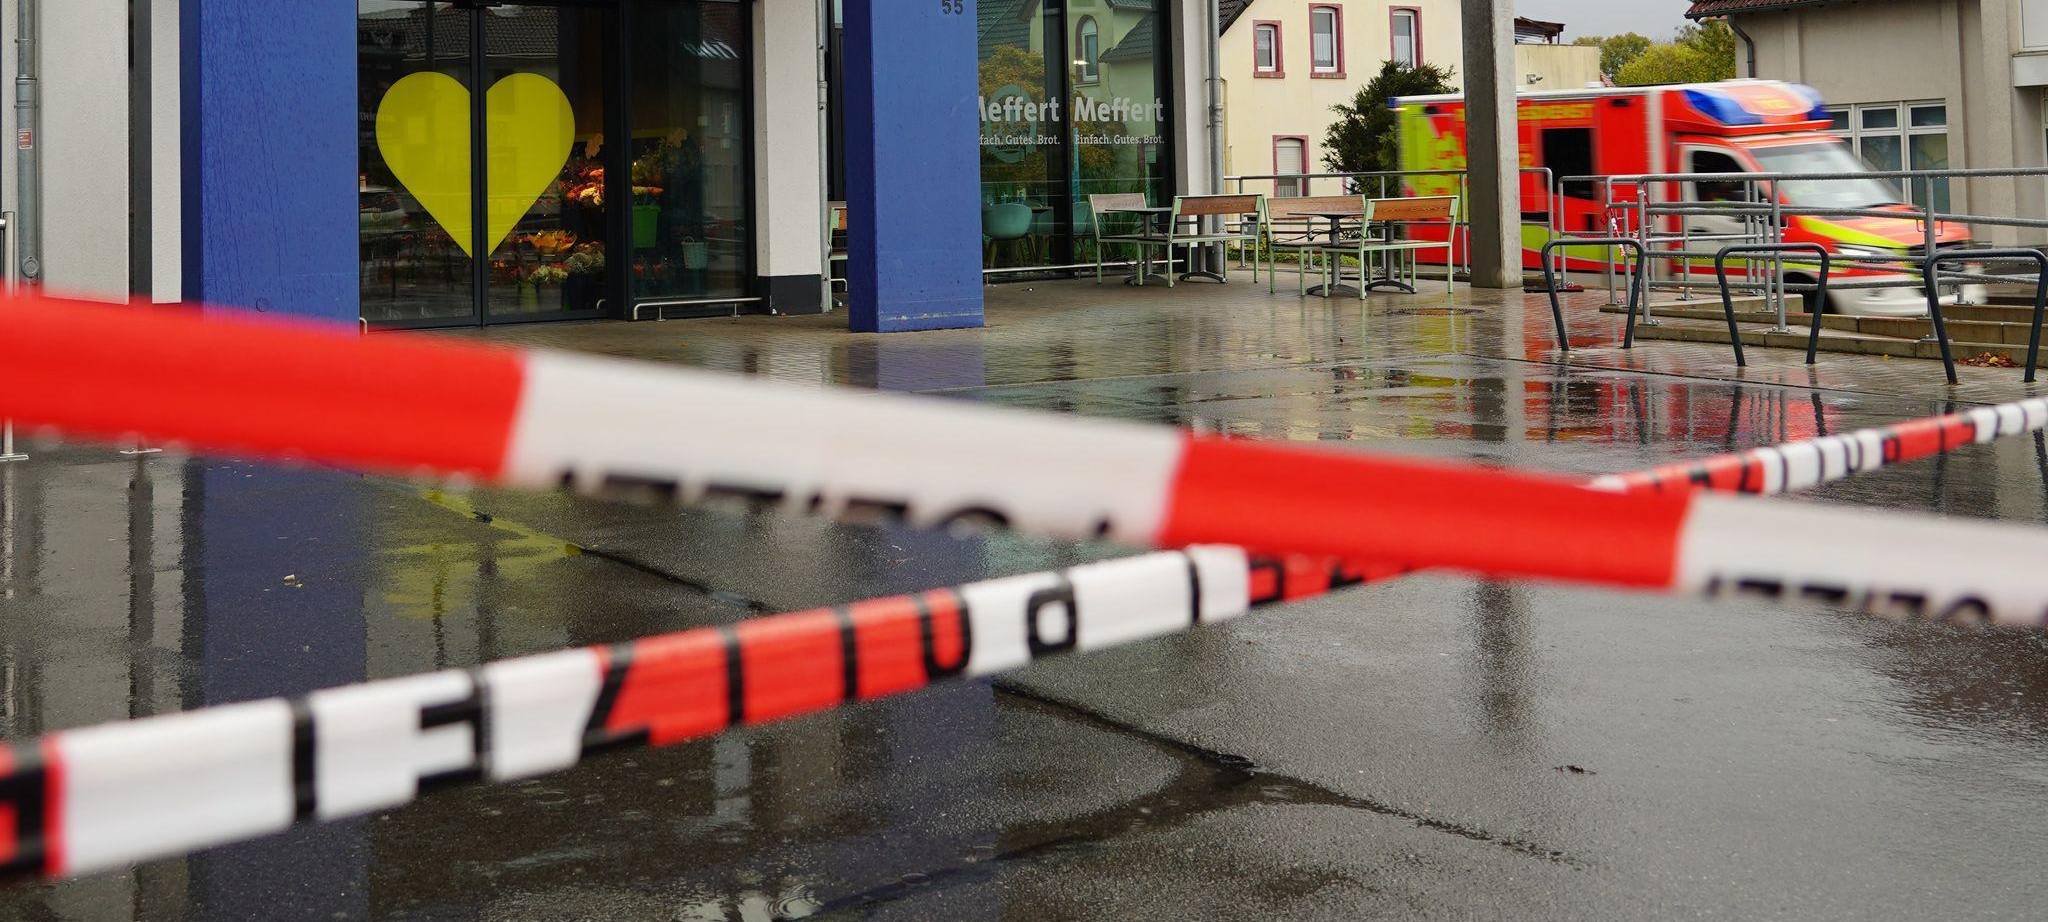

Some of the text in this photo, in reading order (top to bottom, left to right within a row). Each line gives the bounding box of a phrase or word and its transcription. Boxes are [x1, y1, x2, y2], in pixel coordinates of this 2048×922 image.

[1074, 96, 1164, 122] Meffert
[980, 134, 1060, 145] fach. Gutes. Brot.
[1074, 133, 1165, 145] Einfach. Gutes. Brot.
